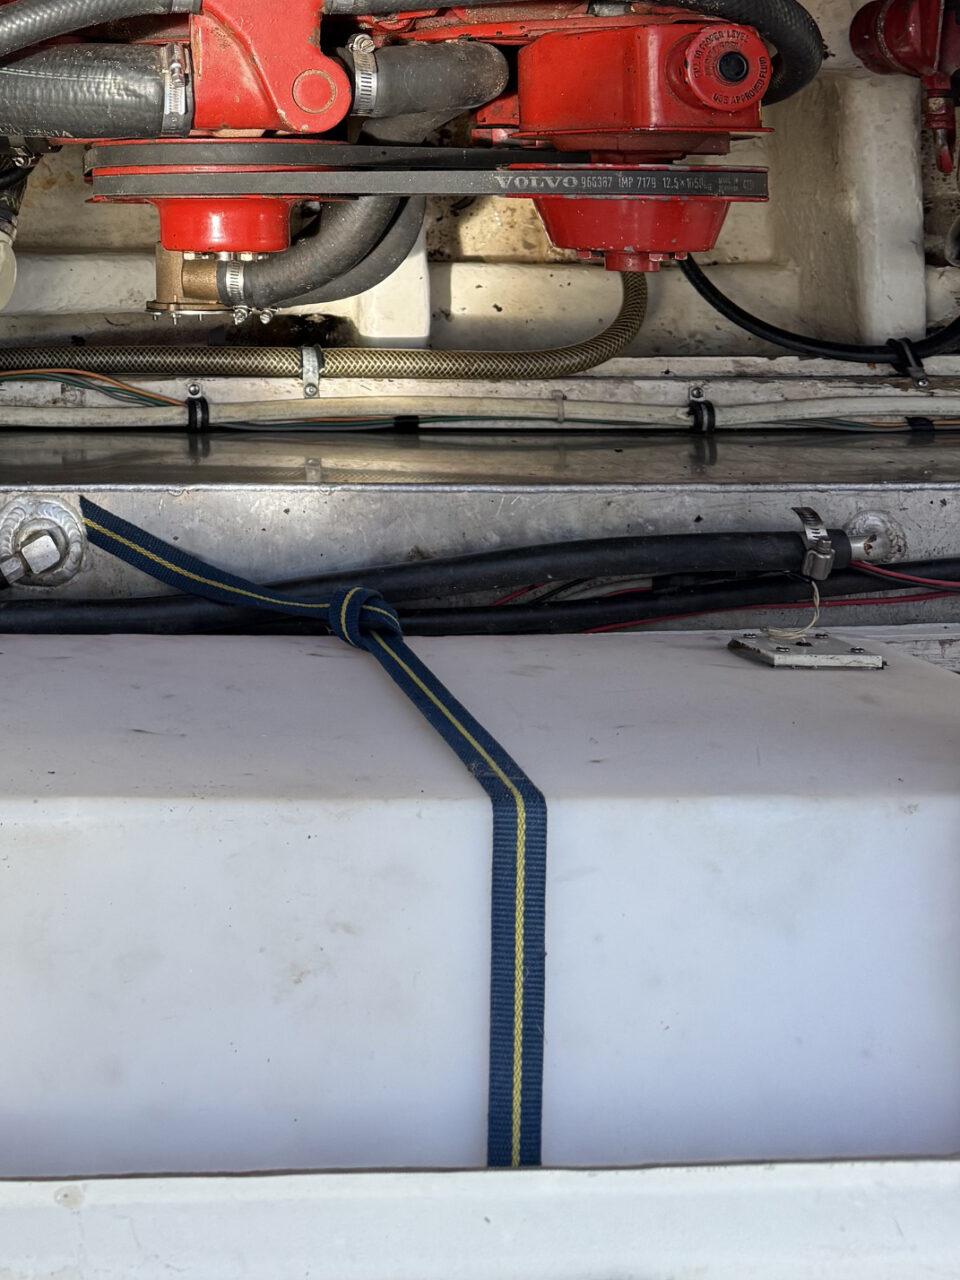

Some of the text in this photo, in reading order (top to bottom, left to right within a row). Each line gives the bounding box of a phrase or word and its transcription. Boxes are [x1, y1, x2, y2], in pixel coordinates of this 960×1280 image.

[726, 28, 750, 42] LEVEL
[712, 92, 728, 104] USE
[730, 79, 766, 104] APPROVED
[758, 56, 768, 78] FLUID
[495, 176, 578, 190] VOLVO
[618, 176, 633, 187] IMP
